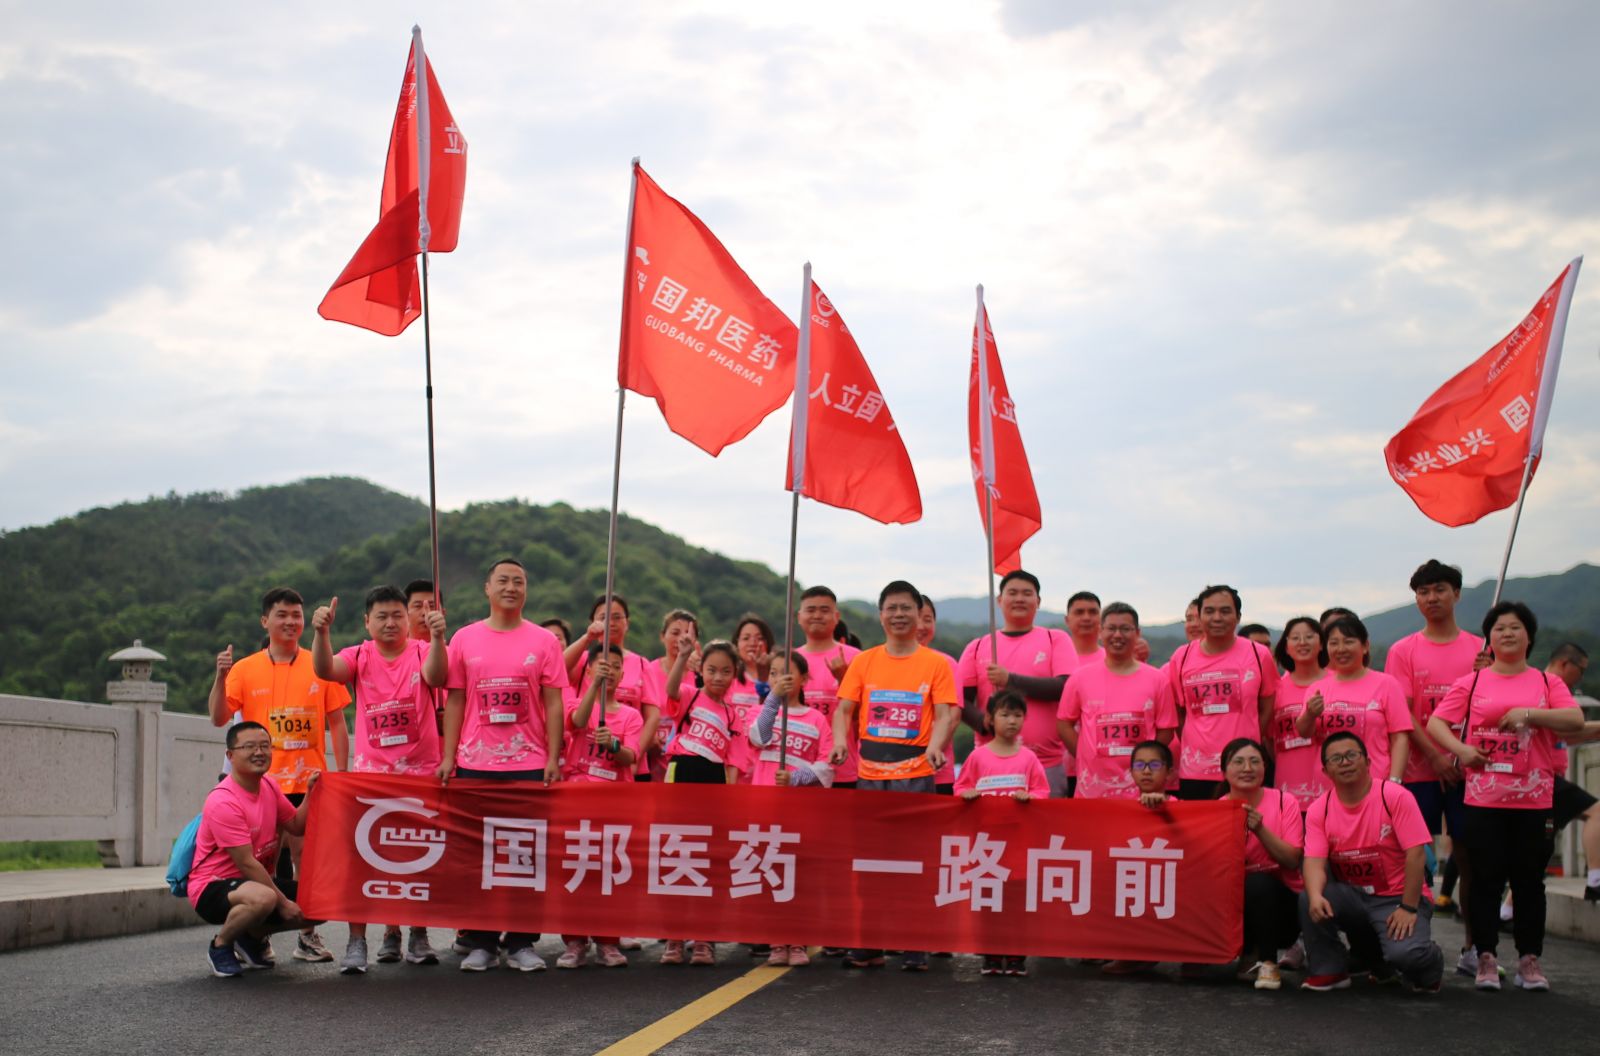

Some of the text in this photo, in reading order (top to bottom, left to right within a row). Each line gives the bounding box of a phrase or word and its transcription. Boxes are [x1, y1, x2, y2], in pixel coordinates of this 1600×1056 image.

[651, 275, 783, 371] 国邦医药
[644, 314, 764, 387] GUOBANG PHARMA
[1192, 682, 1232, 699] 1218
[481, 692, 521, 707] 1329
[371, 712, 409, 729] 1235
[890, 708, 916, 722] 236
[275, 719, 312, 733] 1034
[1102, 724, 1140, 739] 1219
[1480, 738, 1520, 755] 1249
[481, 815, 1184, 920] 国邦医药 一路向前
